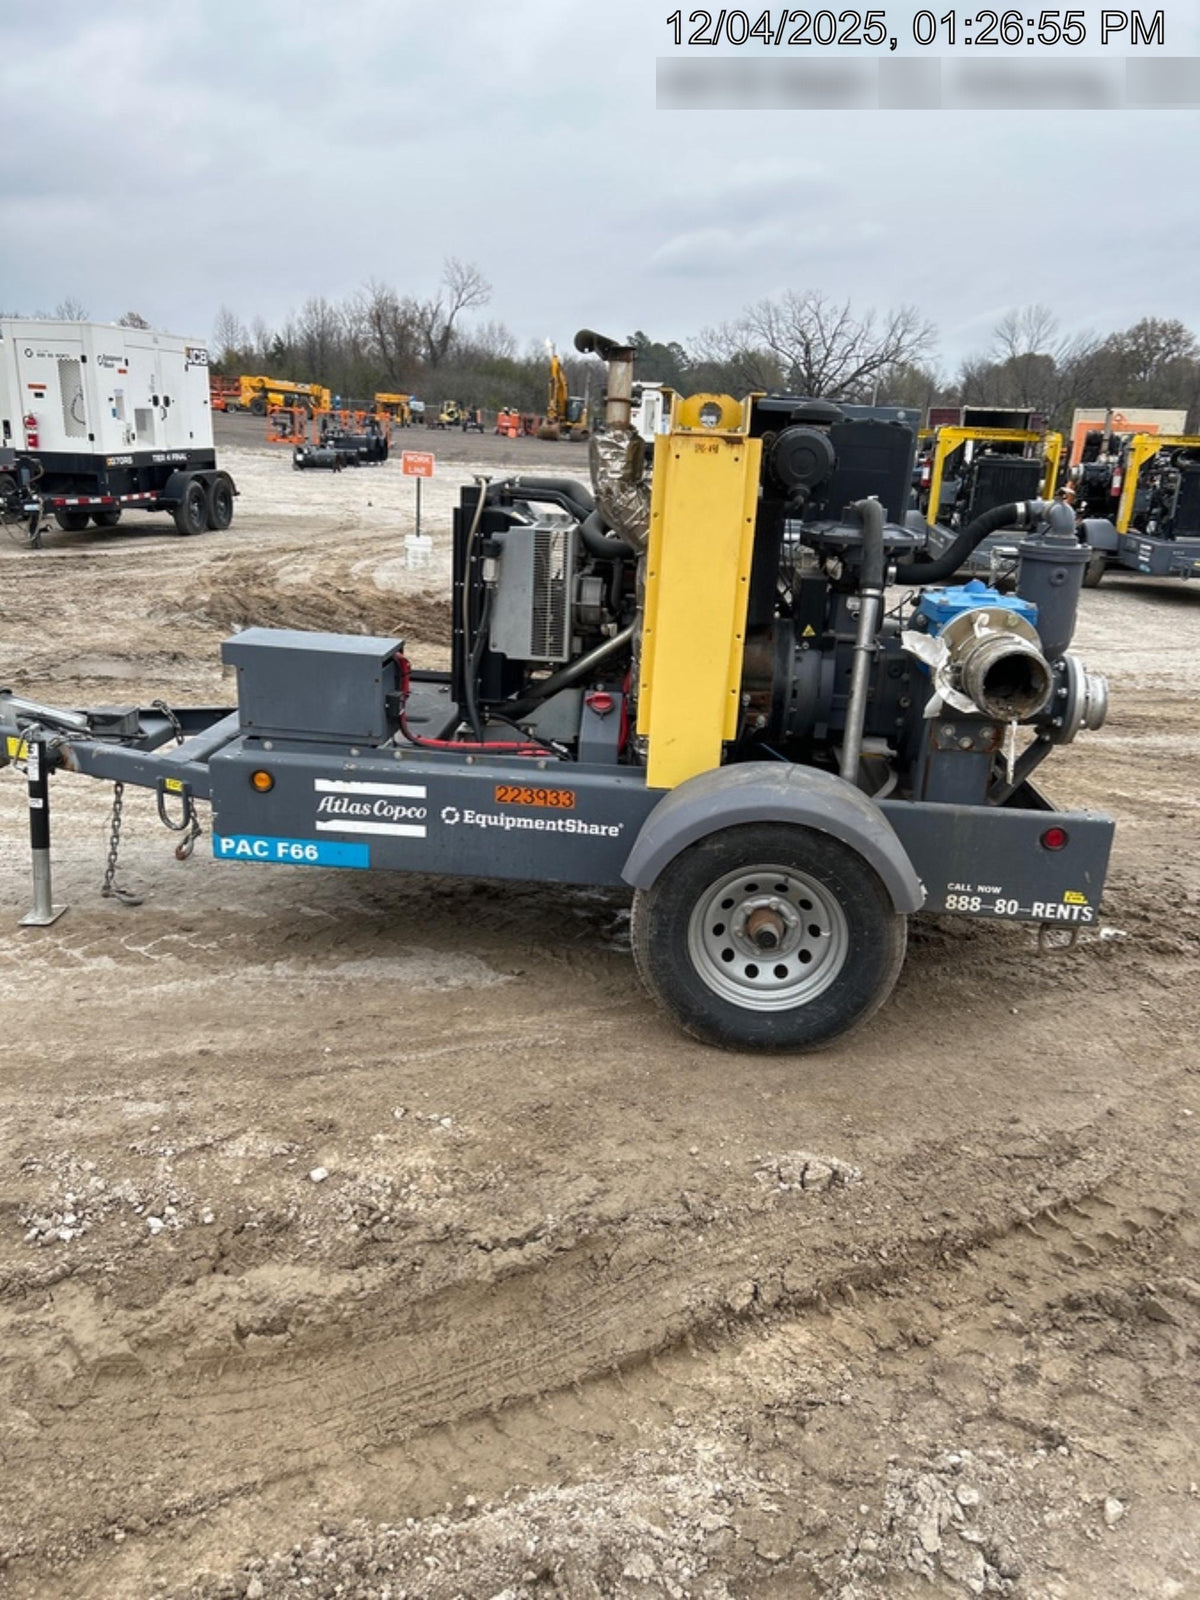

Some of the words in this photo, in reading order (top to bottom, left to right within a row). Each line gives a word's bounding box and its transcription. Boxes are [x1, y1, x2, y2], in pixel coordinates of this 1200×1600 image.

[497, 786, 574, 808] 223933
[316, 796, 371, 815] Atlas
[372, 799, 427, 821] Copco
[220, 838, 269, 857] PAC
[277, 842, 319, 861] F66
[947, 882, 973, 892] CALL
[977, 885, 1002, 894] NOW
